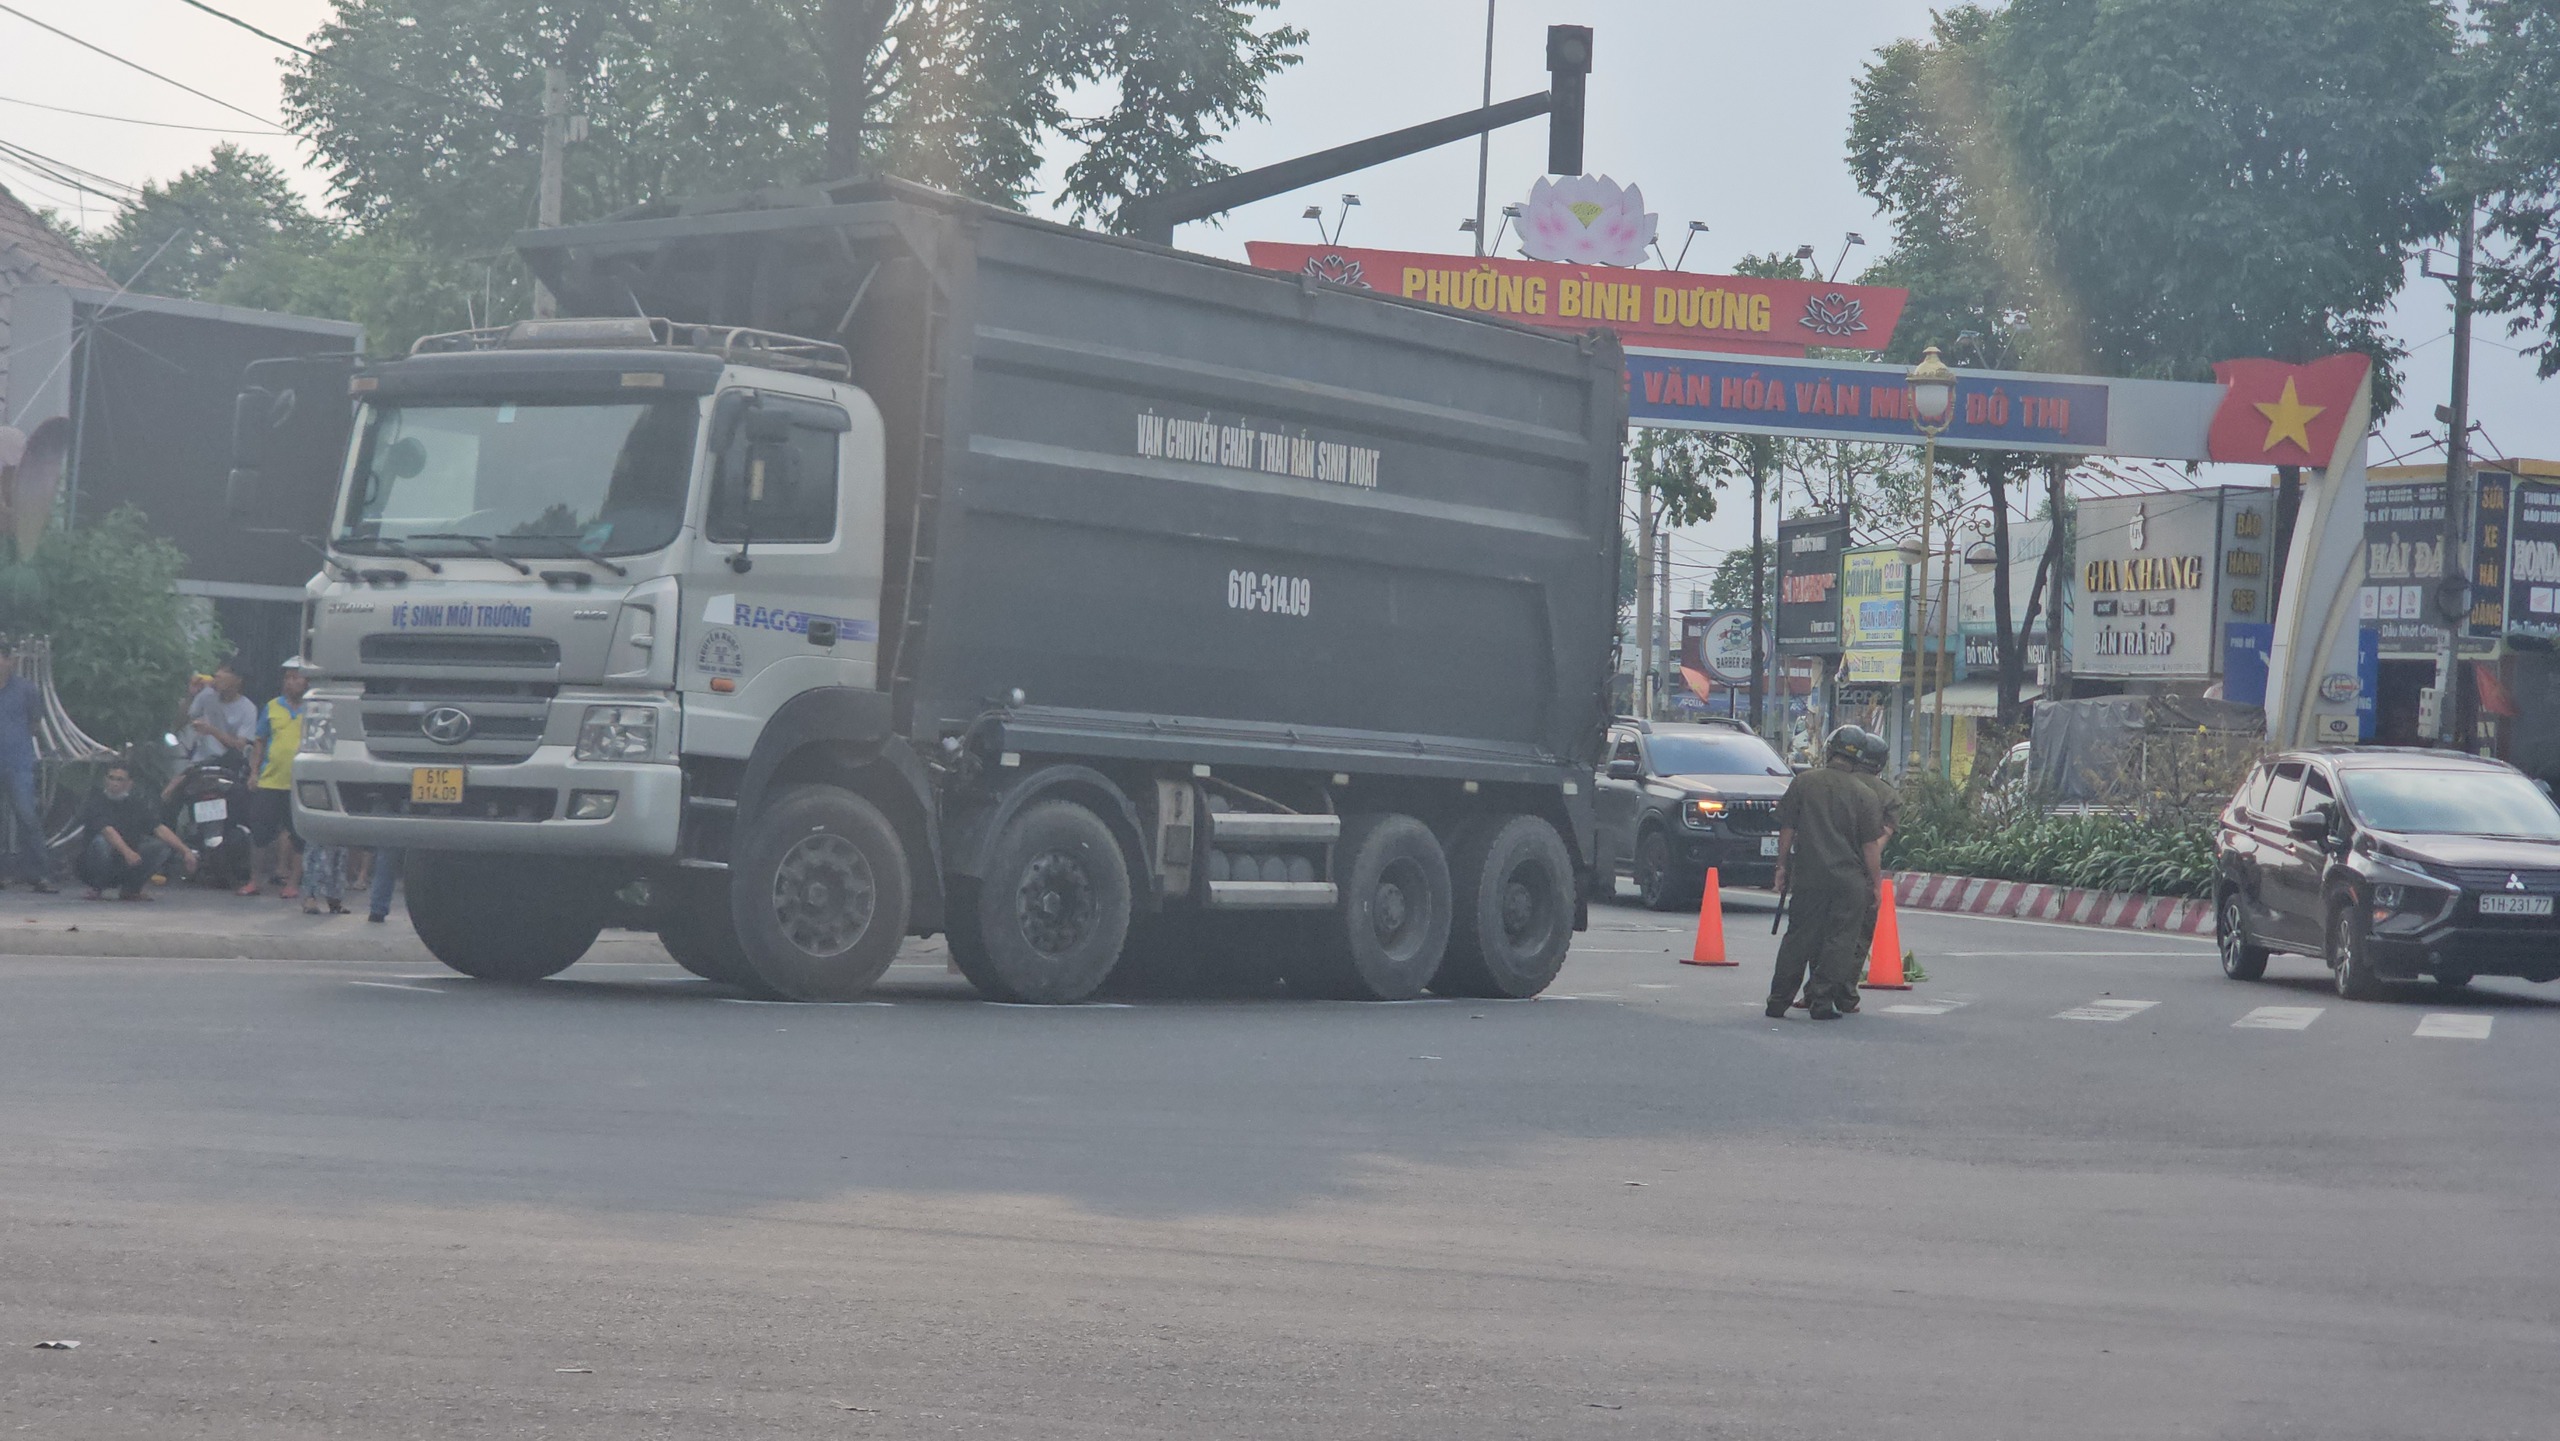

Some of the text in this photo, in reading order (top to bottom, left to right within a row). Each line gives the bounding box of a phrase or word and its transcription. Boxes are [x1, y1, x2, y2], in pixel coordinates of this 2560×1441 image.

[1402, 264, 1771, 332] PHƯỜNG BÌNH DƯƠNG
[1643, 366, 1710, 407] VĂN
[1721, 371, 1787, 412] HÓA
[1795, 377, 1860, 416] VĂN
[1870, 386, 1954, 422] MI
[1966, 386, 2009, 426] ĐÔ
[2020, 395, 2070, 439] THỊ
[1137, 407, 1163, 459] VẬN
[1166, 411, 1217, 464] CHUYỂN
[1221, 417, 1254, 468] CHẤT
[1318, 441, 1347, 483] SINH
[1350, 446, 1380, 491] HOẠT
[2483, 525, 2499, 548] XE
[2085, 556, 2202, 592] GIA KHANG
[2513, 540, 2560, 582] HOND
[1228, 569, 1310, 617] 61C-314.09
[410, 605, 442, 628] SINH
[446, 601, 471, 628] MÔI
[476, 600, 532, 628] TRƯỜNG
[2094, 622, 2174, 655] BÁN TRẢ GÓP
[427, 770, 448, 784] 61C
